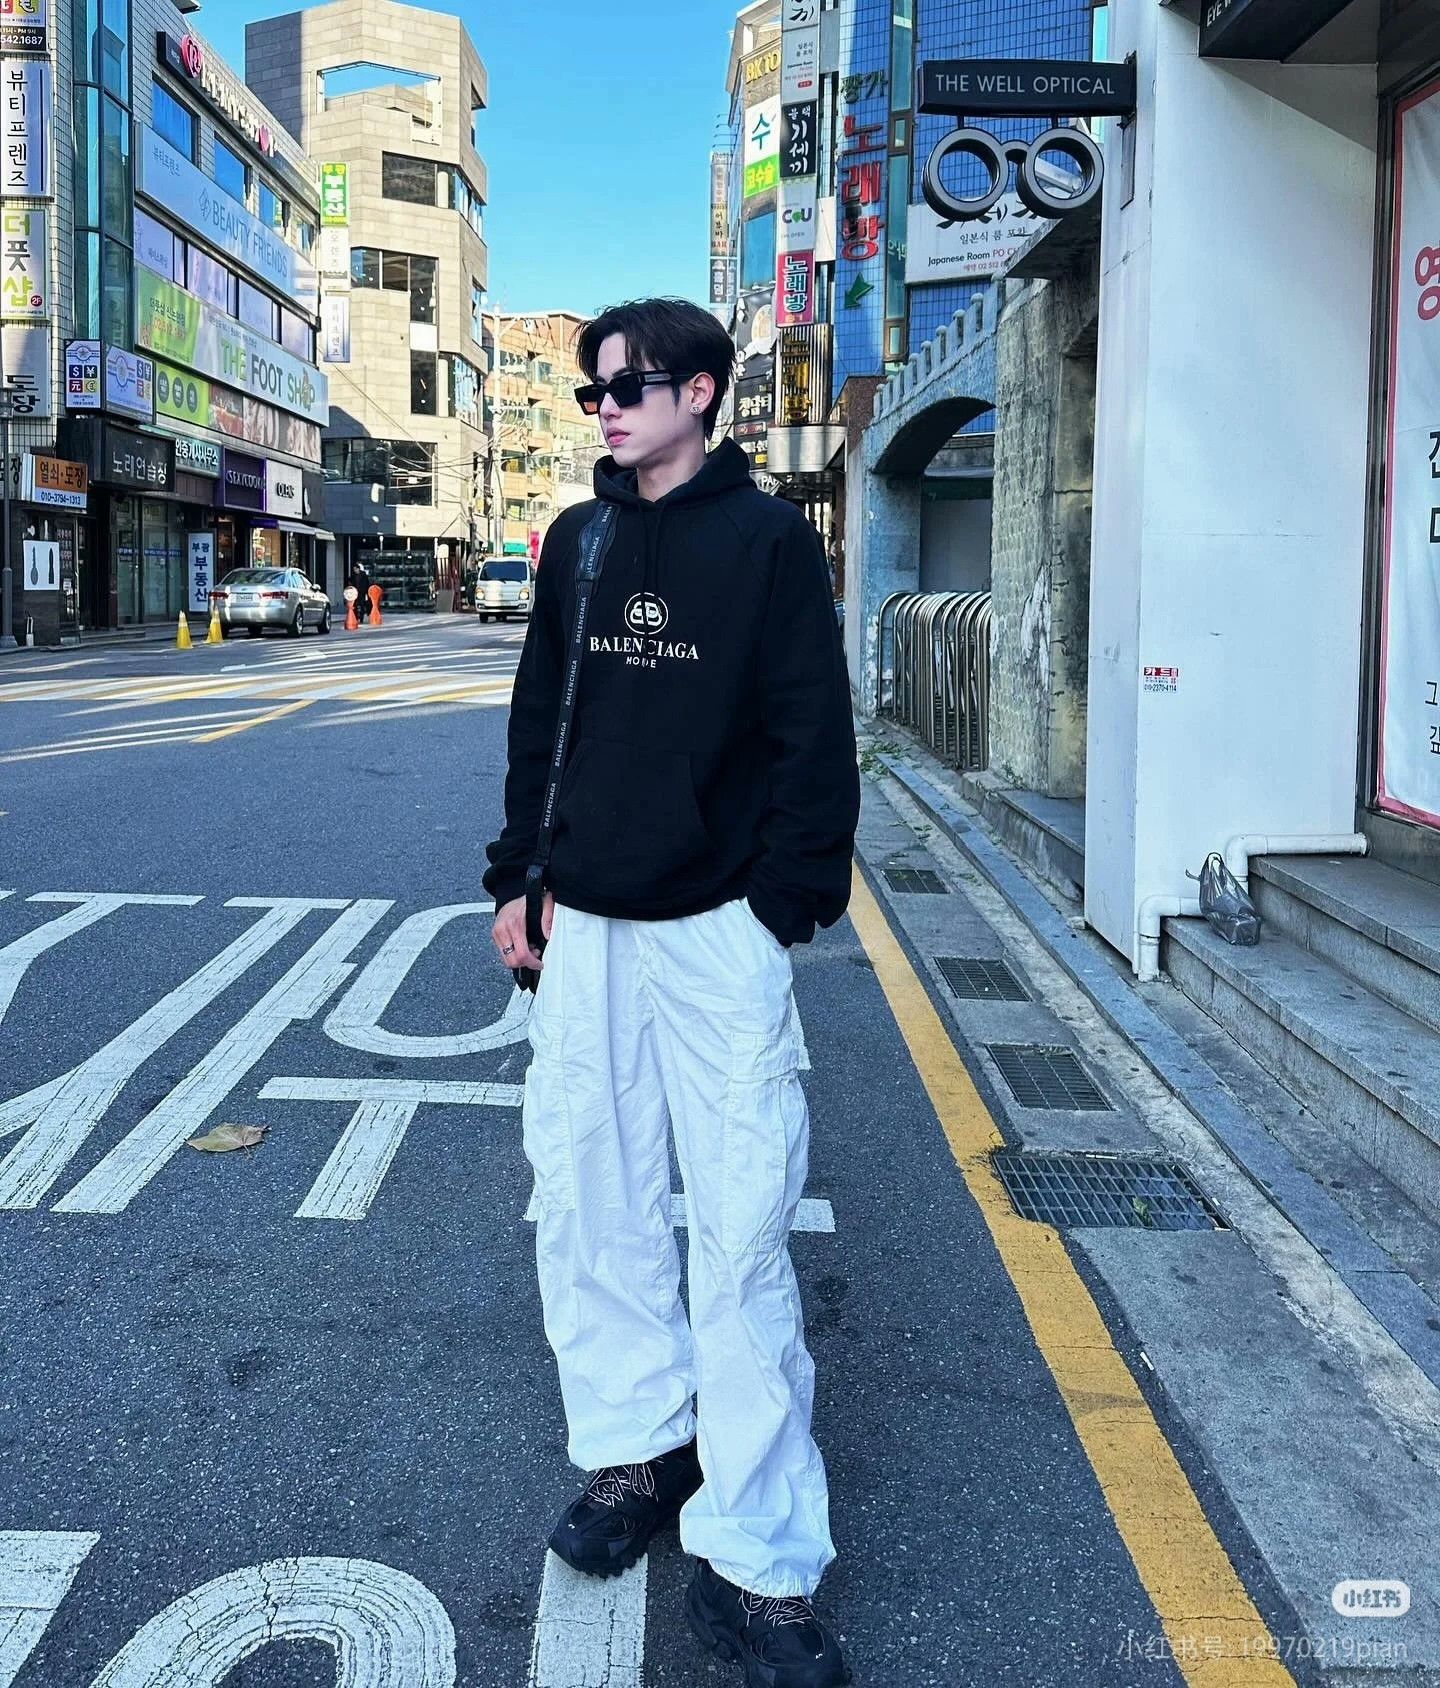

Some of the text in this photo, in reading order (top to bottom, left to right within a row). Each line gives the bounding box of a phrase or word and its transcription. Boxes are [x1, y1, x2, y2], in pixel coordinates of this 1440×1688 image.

[935, 74, 1115, 95] THE WELL OPTICAL
[7, 69, 29, 187] 뷰티프렌즈
[841, 115, 887, 261] 노래방
[213, 200, 251, 249] BEAUTY
[253, 231, 288, 279] FRIENDS
[928, 256, 965, 267] Japanese
[967, 252, 990, 261] Room
[993, 249, 1004, 257] PO
[32, 296, 41, 305] 2F
[784, 255, 808, 313] 노래방
[221, 339, 247, 382] THE
[251, 353, 283, 398] FOOT
[113, 452, 167, 485] 노래연습장
[194, 556, 209, 602] 부동산
[576, 597, 587, 643] BALENCIAGA
[589, 636, 699, 660] BALENCIAGA
[565, 660, 578, 706] BALENCIAGA
[554, 722, 568, 767] BALENCIAGA
[543, 782, 557, 828] BALENCIAGA
